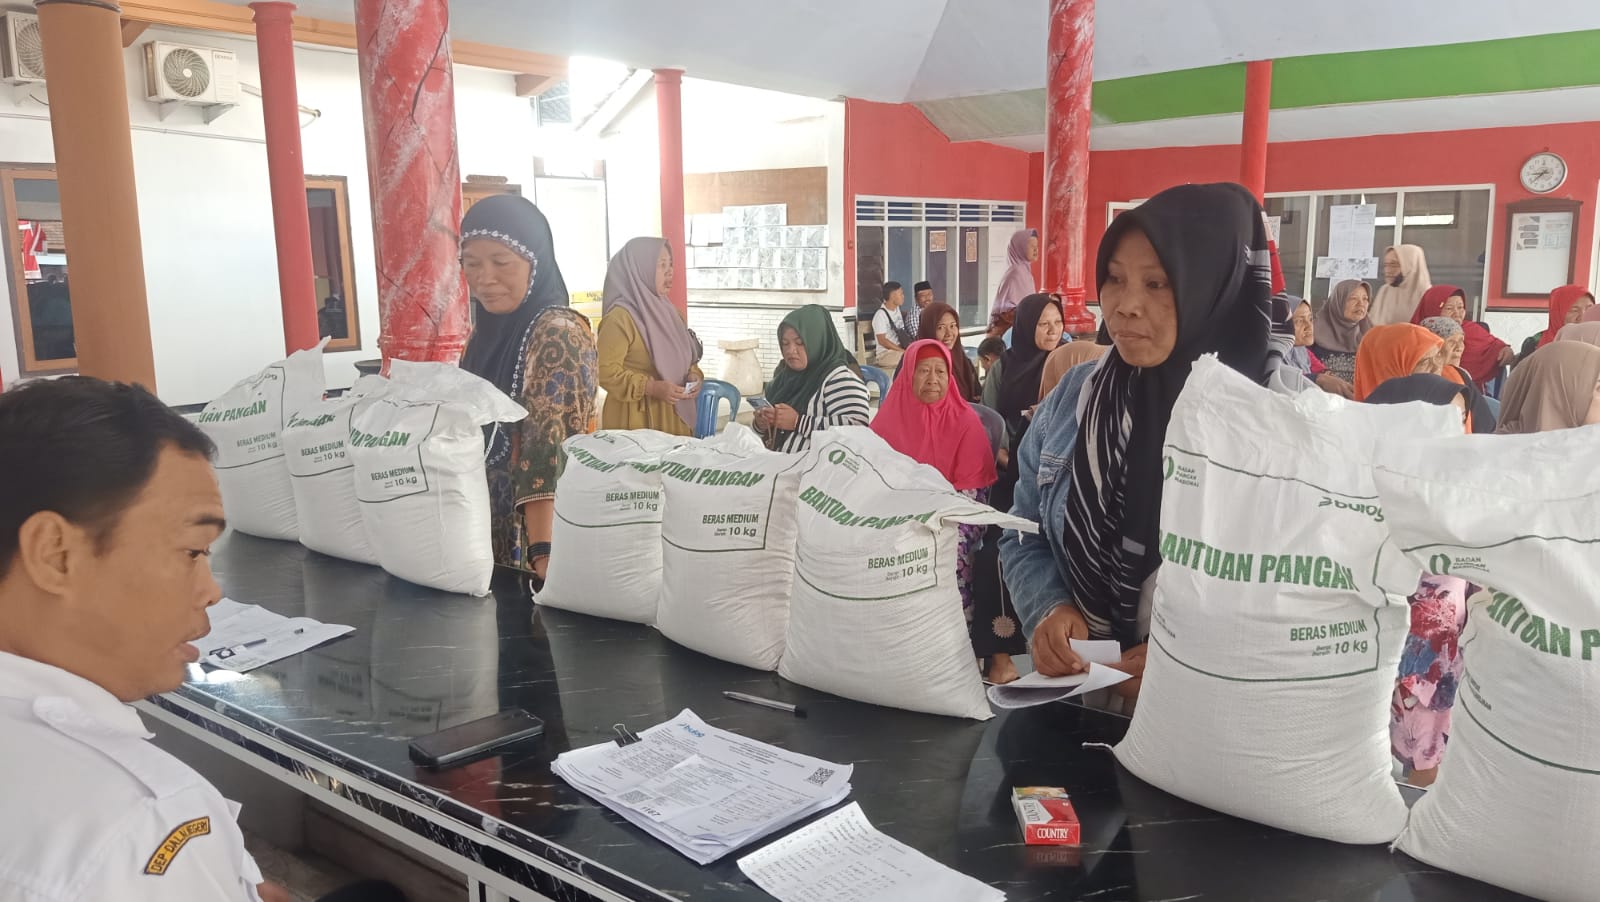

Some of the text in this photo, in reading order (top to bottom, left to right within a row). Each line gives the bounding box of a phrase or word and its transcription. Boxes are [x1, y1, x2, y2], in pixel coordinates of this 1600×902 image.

[223, 400, 267, 421] PANGAN
[237, 432, 276, 447] BERAS MEDIUM
[257, 443, 266, 451] 10
[267, 441, 278, 449] kg
[301, 440, 344, 456] BERAS MEDIUM
[323, 452, 332, 460] 10
[335, 450, 345, 458] kg
[371, 466, 415, 481] BERAS MEDIUM
[395, 478, 404, 486] 10
[406, 476, 417, 485] kg
[696, 468, 765, 487] PANGAN
[606, 490, 659, 502] BERAS MEDIUM
[633, 502, 643, 510] 10
[646, 501, 658, 512] kg
[799, 485, 865, 526] BANTUAN
[702, 513, 759, 524] BERAS MEDIUM
[729, 526, 740, 536] 10
[743, 526, 757, 537] kg
[867, 547, 928, 569] BERAS MEDIUM
[1159, 529, 1253, 582] ANTUAN
[901, 563, 928, 578] 10 kg
[1486, 586, 1571, 658] ANTUAN
[1290, 619, 1368, 641] BERAS MEDIUM
[1335, 639, 1368, 655] 10 kg
[1037, 827, 1069, 839] COUNTRY
[150, 853, 168, 873] DEP
